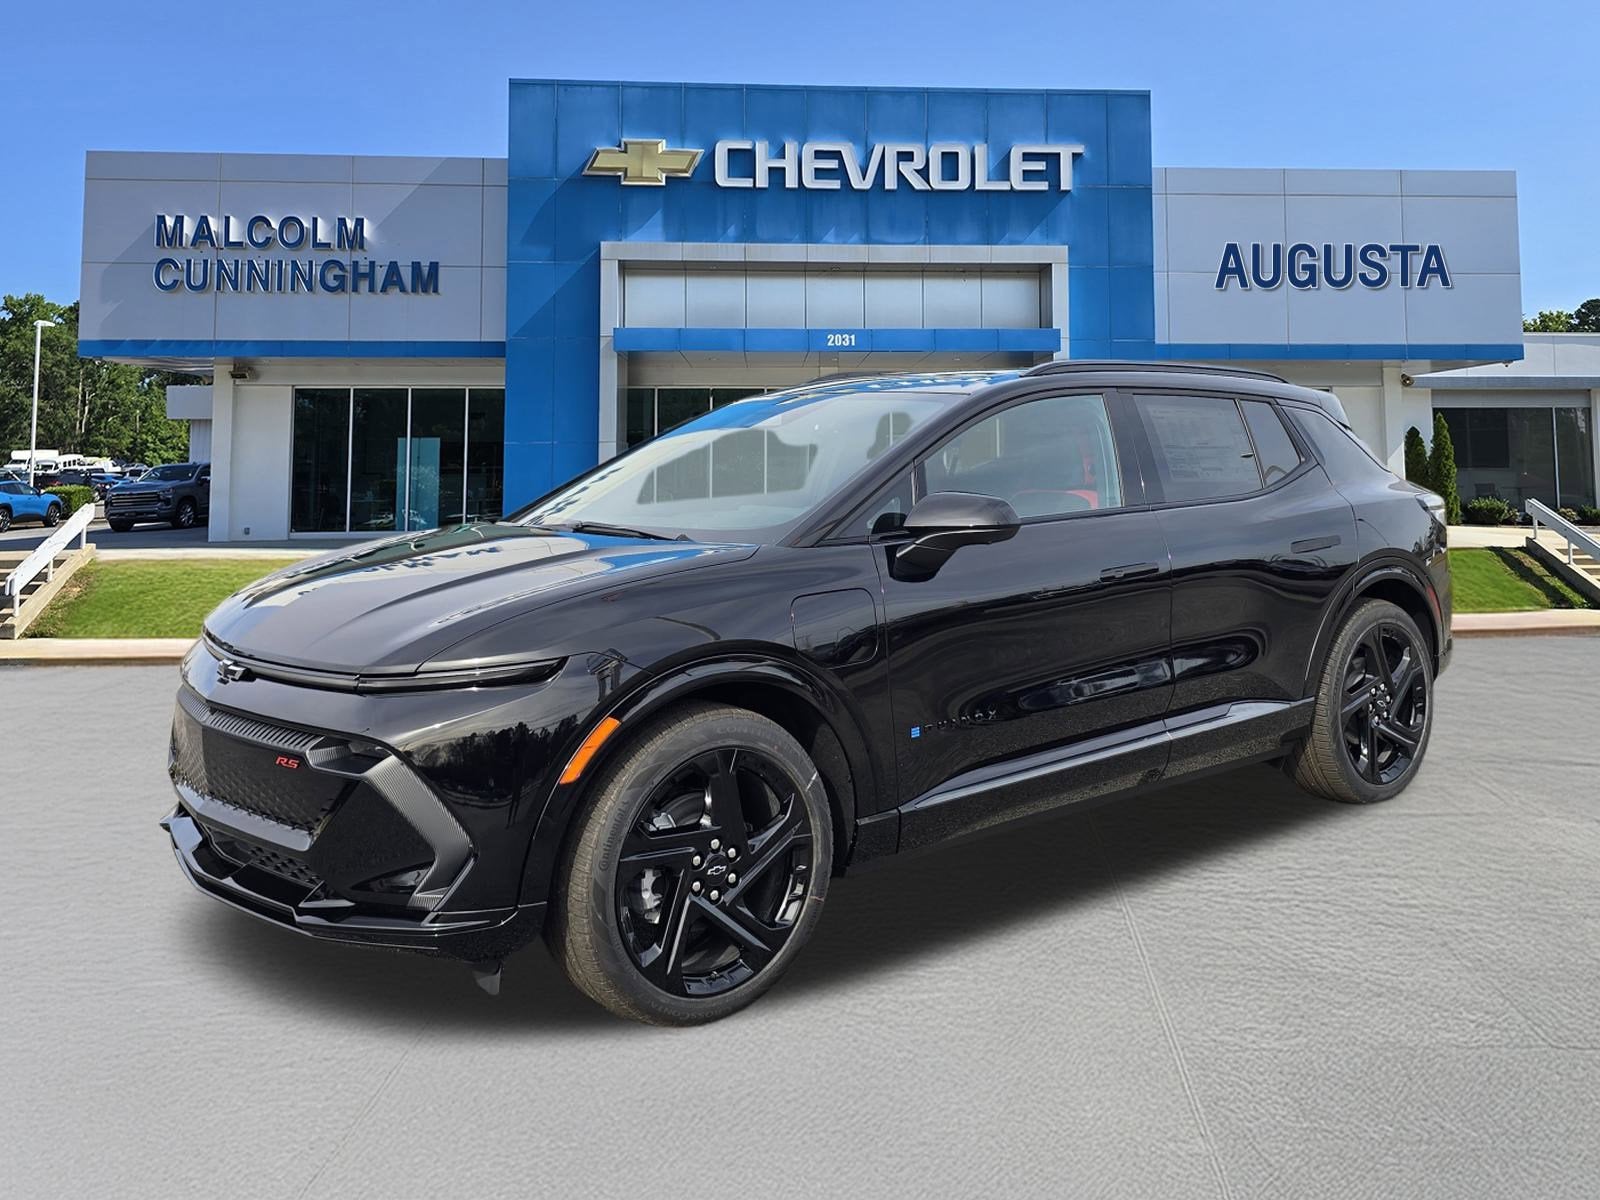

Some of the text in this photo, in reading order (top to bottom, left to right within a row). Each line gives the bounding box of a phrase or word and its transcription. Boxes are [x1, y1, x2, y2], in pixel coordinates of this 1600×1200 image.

[714, 139, 1085, 191] CHEVROLET
[155, 214, 366, 250] MALCOLM
[154, 257, 441, 293] CUNNINGHAM
[1214, 241, 1453, 290] AUGUSTA
[827, 333, 856, 347] 2031
[275, 756, 300, 769] RS
